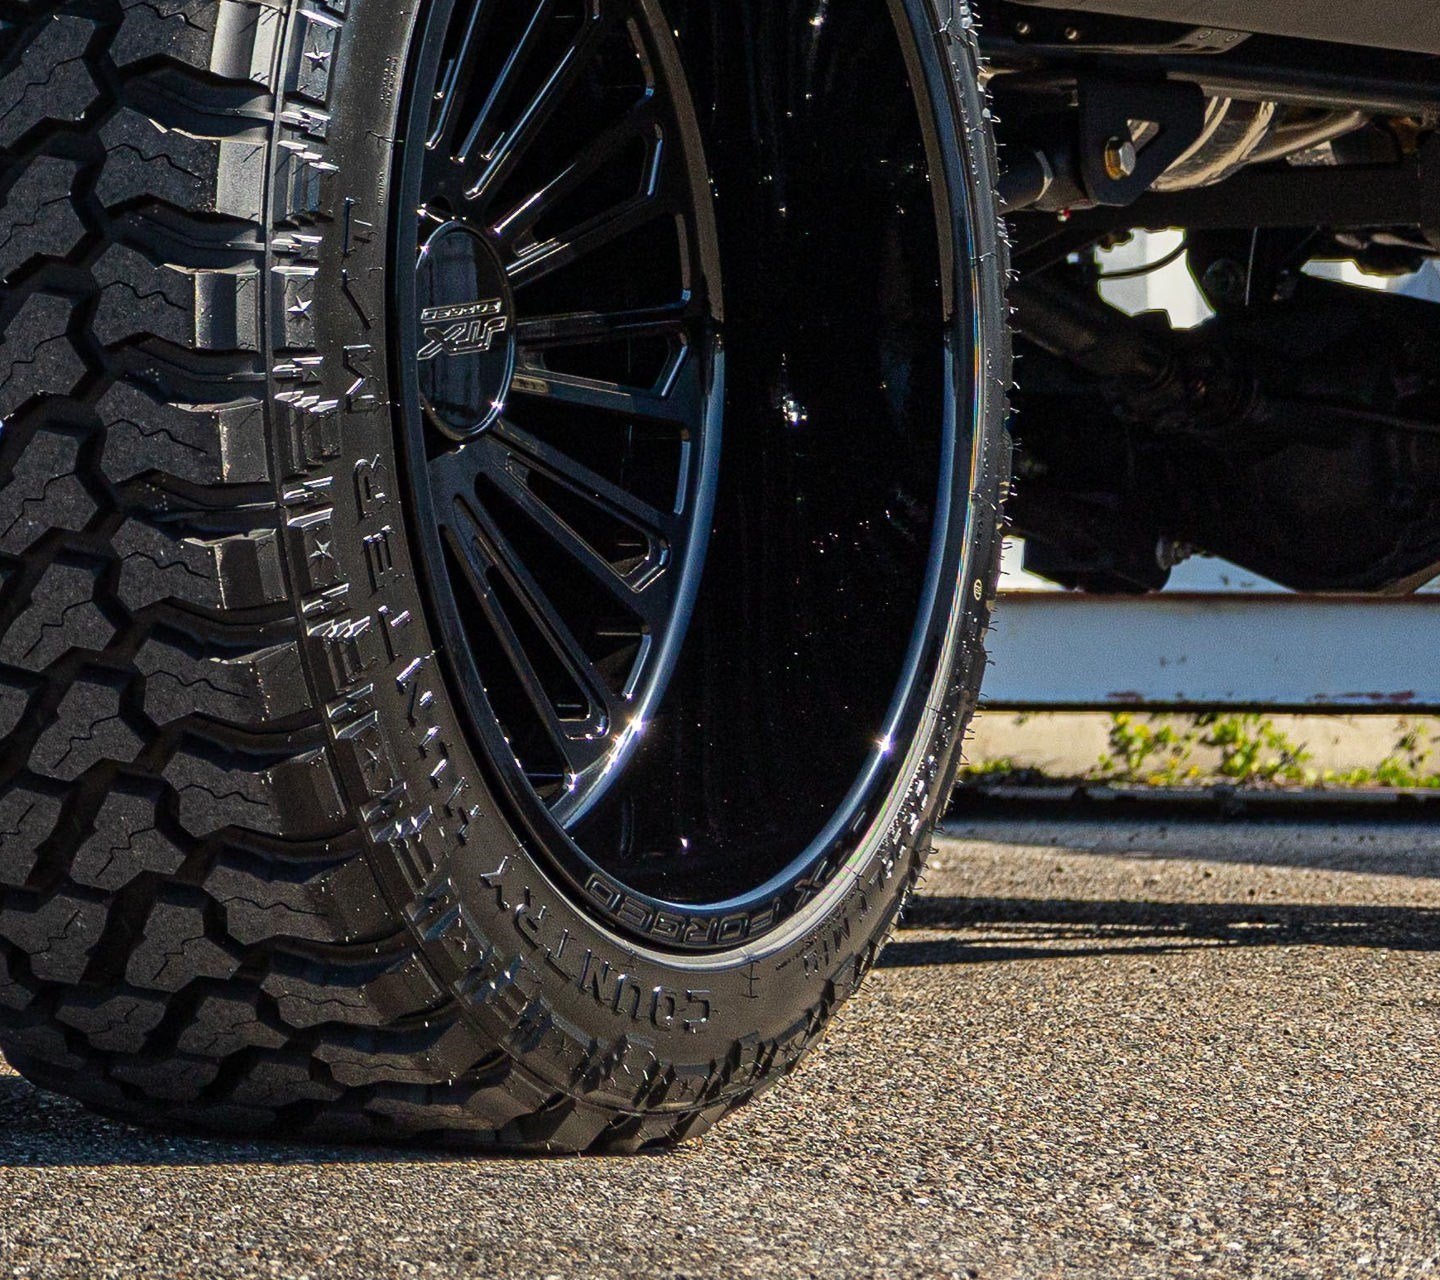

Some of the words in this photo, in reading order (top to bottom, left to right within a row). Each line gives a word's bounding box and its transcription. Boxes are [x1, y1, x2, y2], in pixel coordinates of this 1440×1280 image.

[416, 315, 508, 361] JTX
[354, 454, 482, 844] HUNTER
[479, 854, 715, 1035] COUNTRY
[584, 872, 782, 944] FORGED
